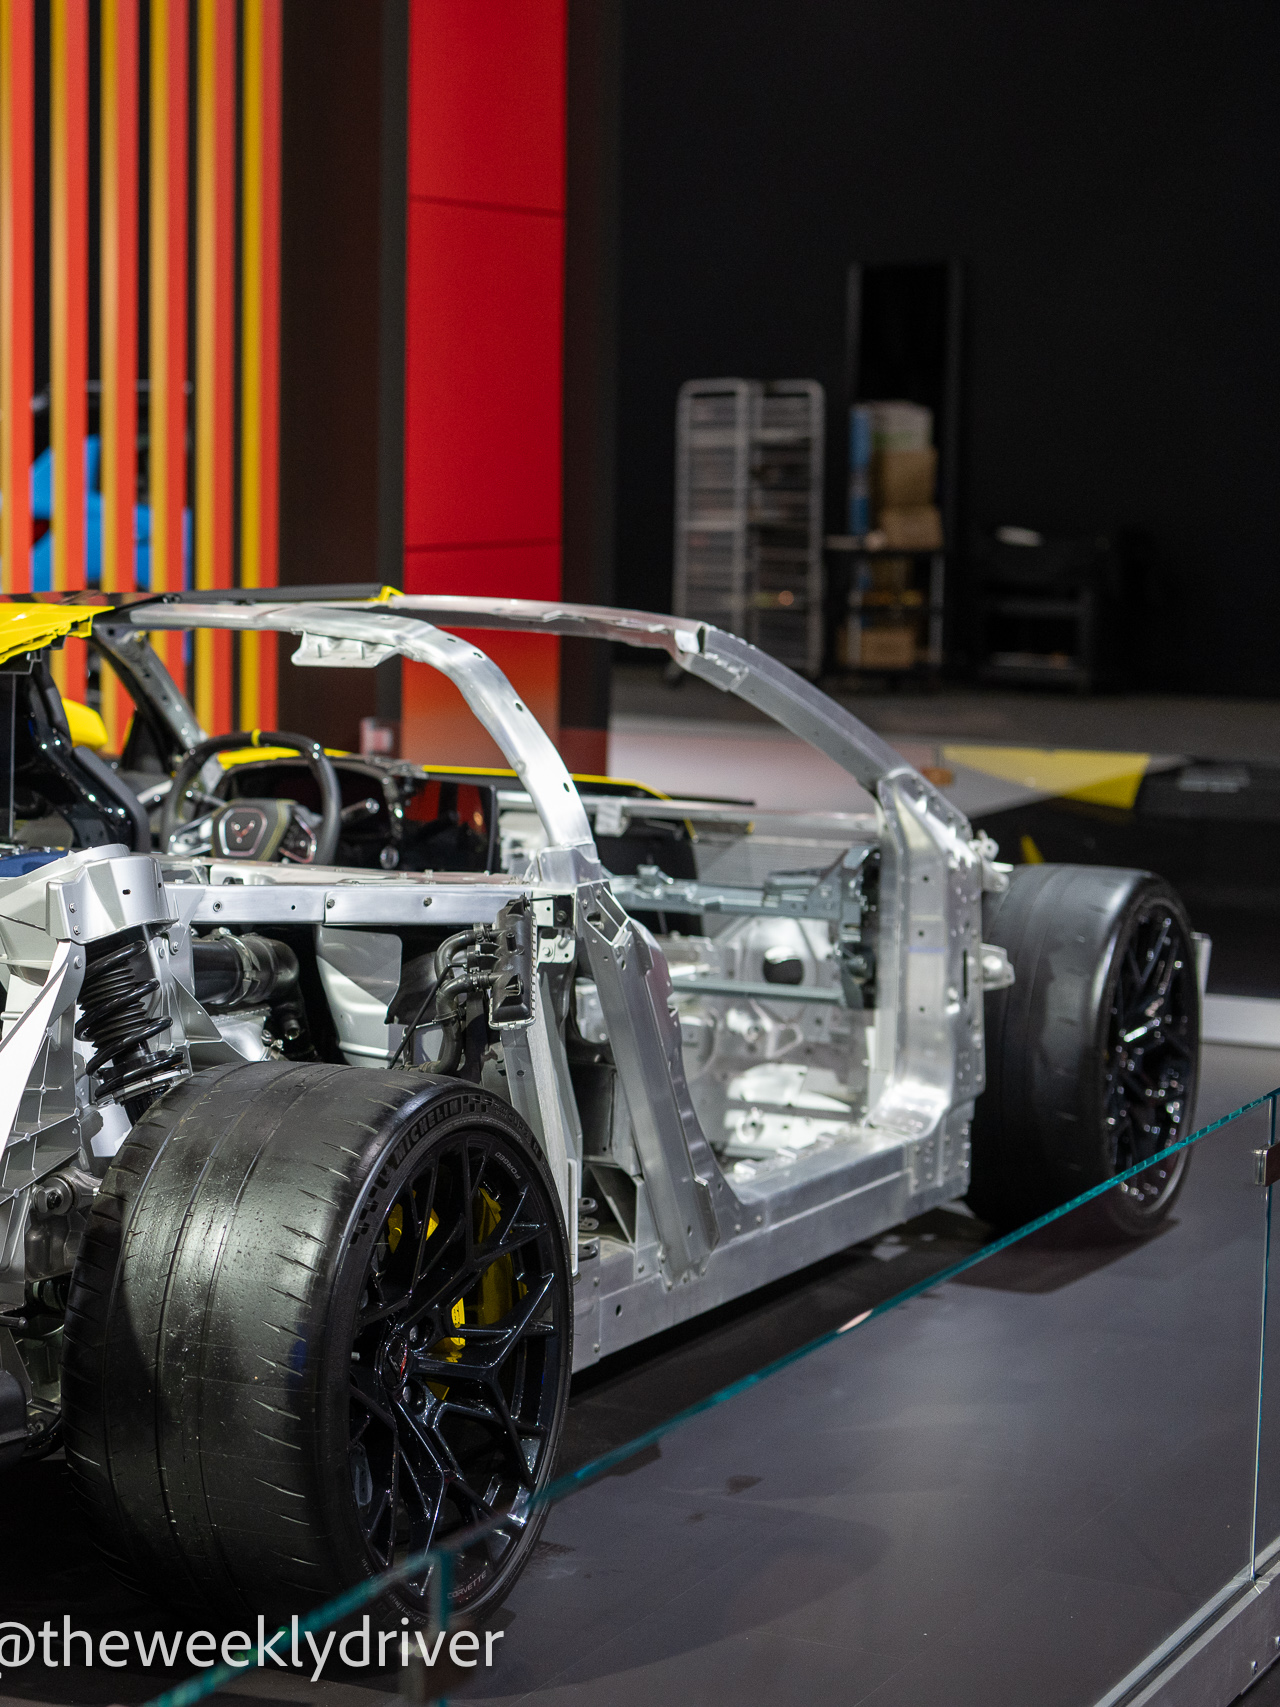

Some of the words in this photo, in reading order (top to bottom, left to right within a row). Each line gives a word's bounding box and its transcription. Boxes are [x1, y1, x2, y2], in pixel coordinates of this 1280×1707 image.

[393, 1099, 460, 1165] MICHELIN
[495, 1152, 521, 1179] FORGED
[447, 1569, 487, 1599] CORVETTE
